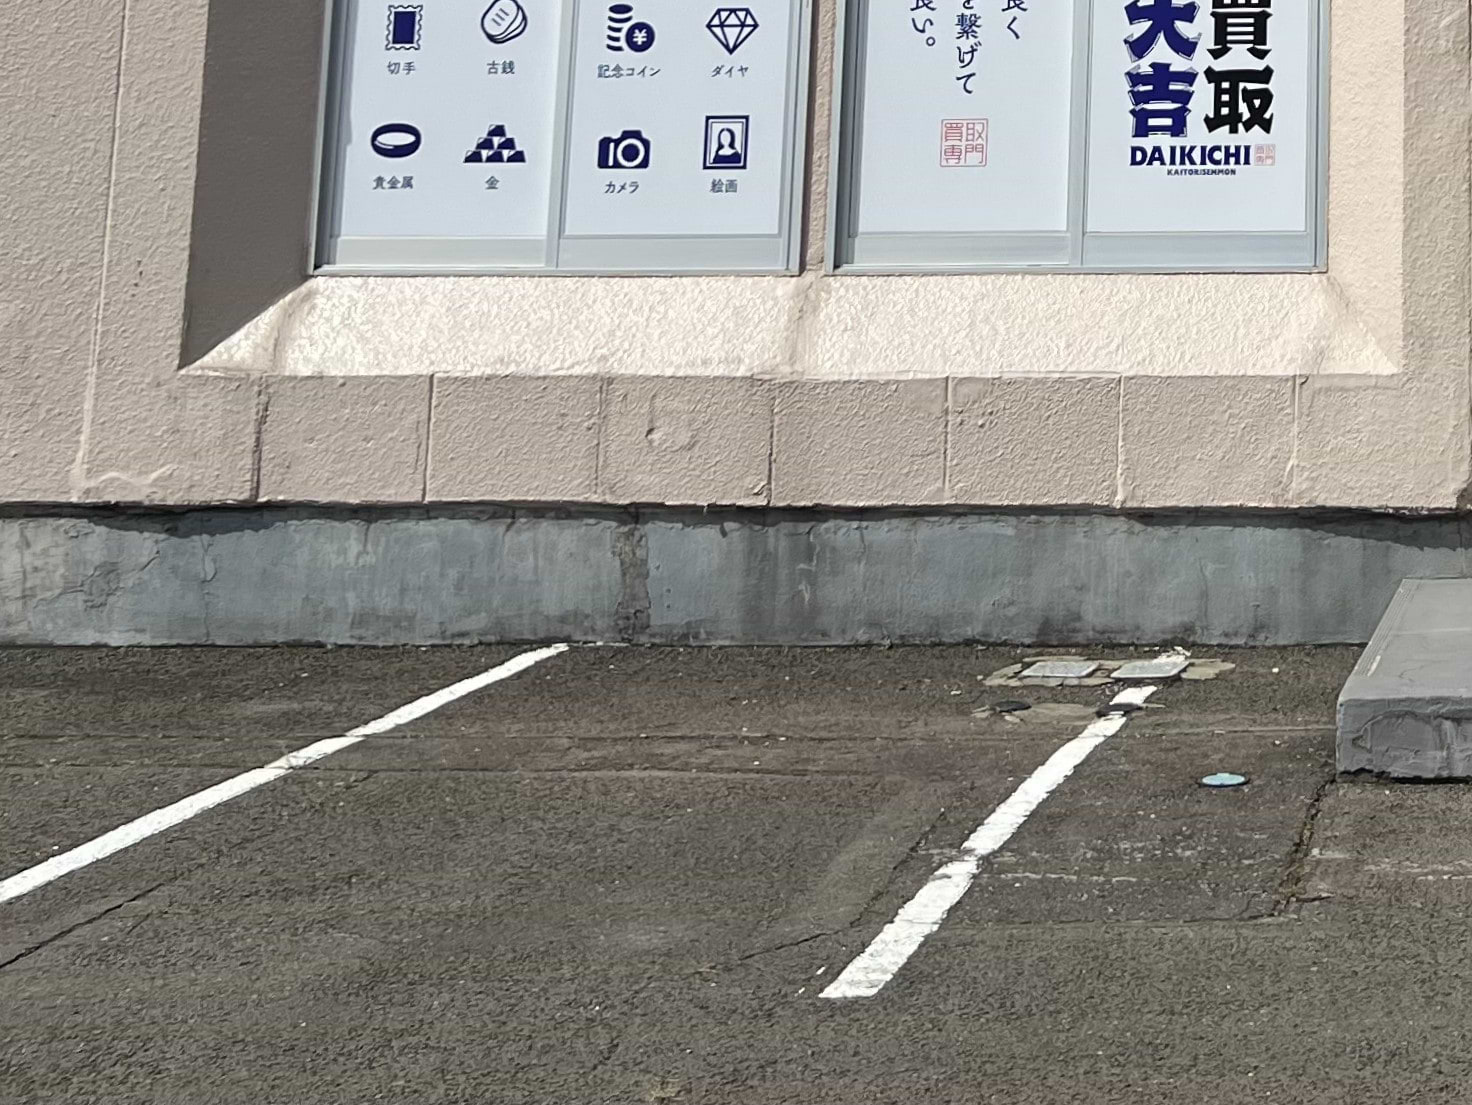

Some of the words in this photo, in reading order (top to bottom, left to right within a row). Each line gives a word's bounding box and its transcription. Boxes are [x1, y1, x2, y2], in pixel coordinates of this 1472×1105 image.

[387, 61, 416, 76] 切手
[486, 60, 516, 75] 古銭
[597, 63, 661, 79] 記念コイン
[711, 64, 749, 78] ダイヤ
[1129, 144, 1252, 167] DAIKICHI
[372, 176, 414, 190] 貴金属
[485, 176, 500, 190] 金
[604, 181, 640, 194] カメラ
[709, 178, 738, 194] 絵画
